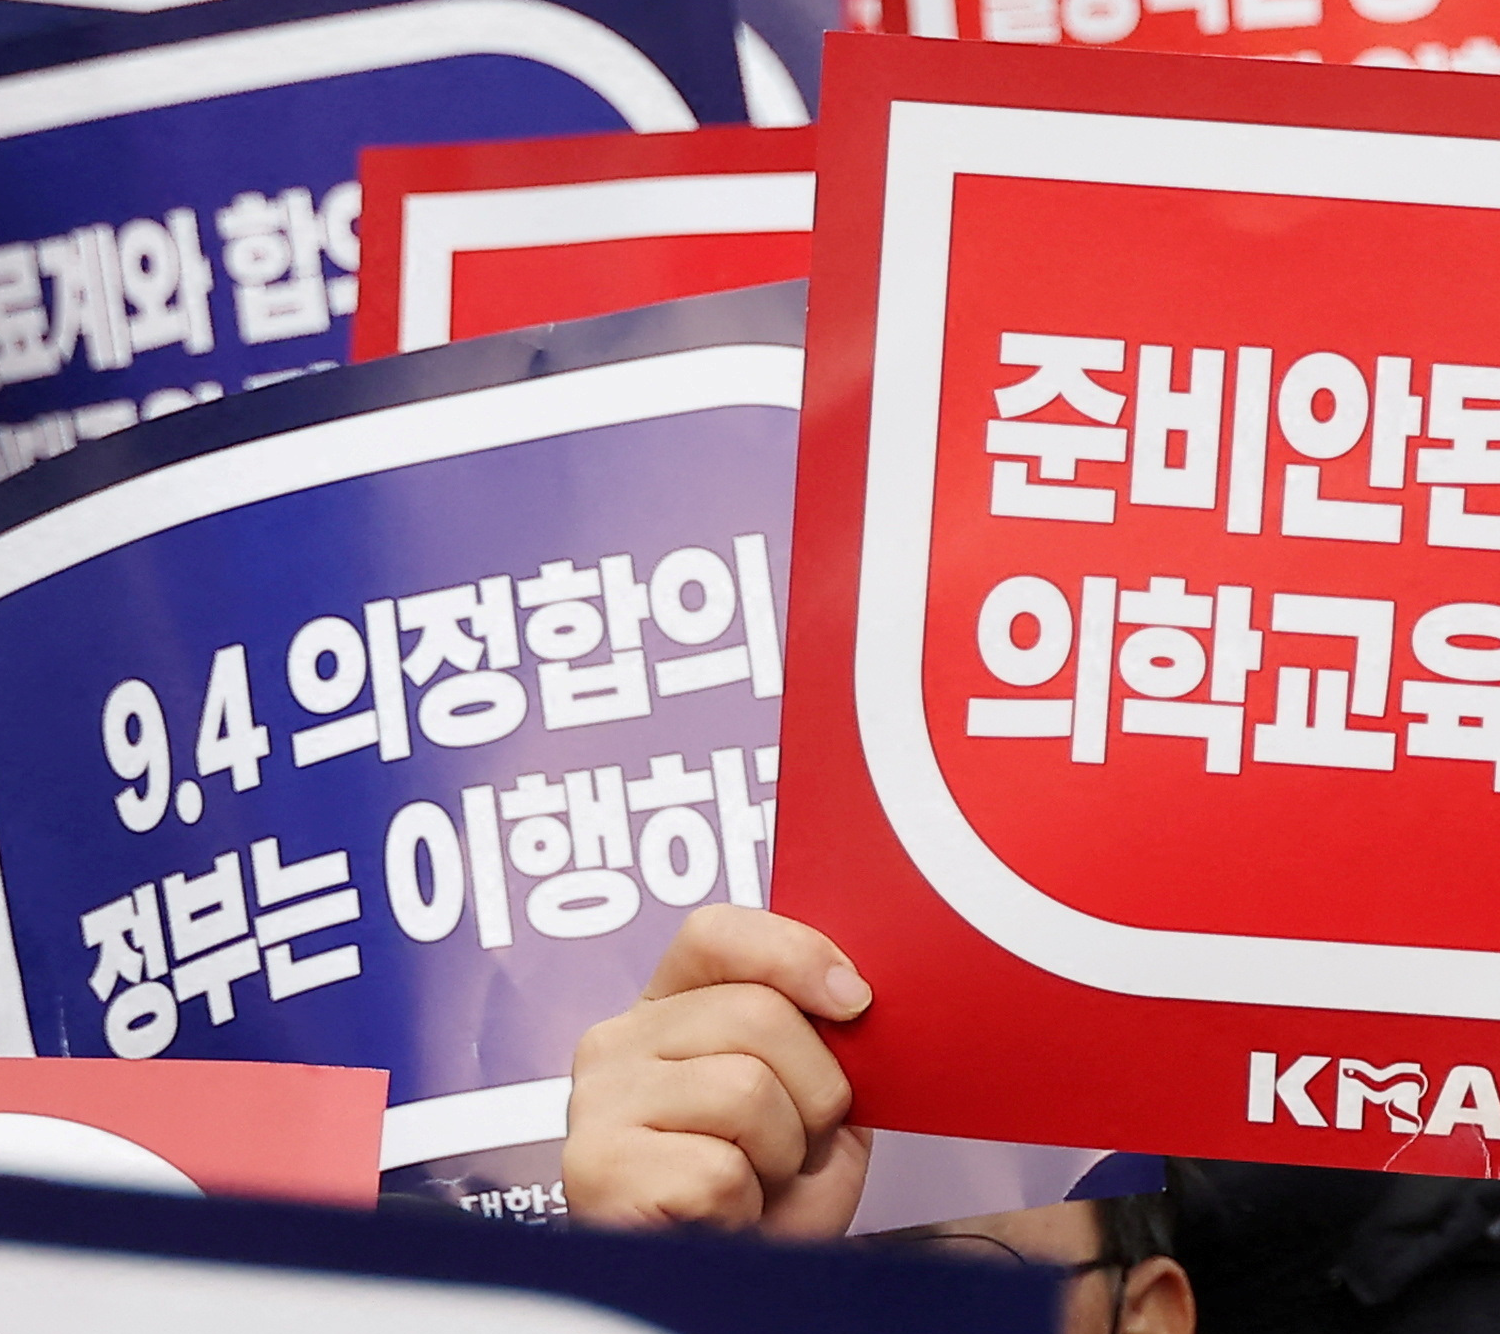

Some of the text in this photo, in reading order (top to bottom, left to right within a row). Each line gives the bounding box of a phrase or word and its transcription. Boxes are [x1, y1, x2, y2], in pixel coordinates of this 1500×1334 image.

[101, 532, 784, 833] 9.4 의정합의
[79, 745, 780, 1060] 정부는 이행하
